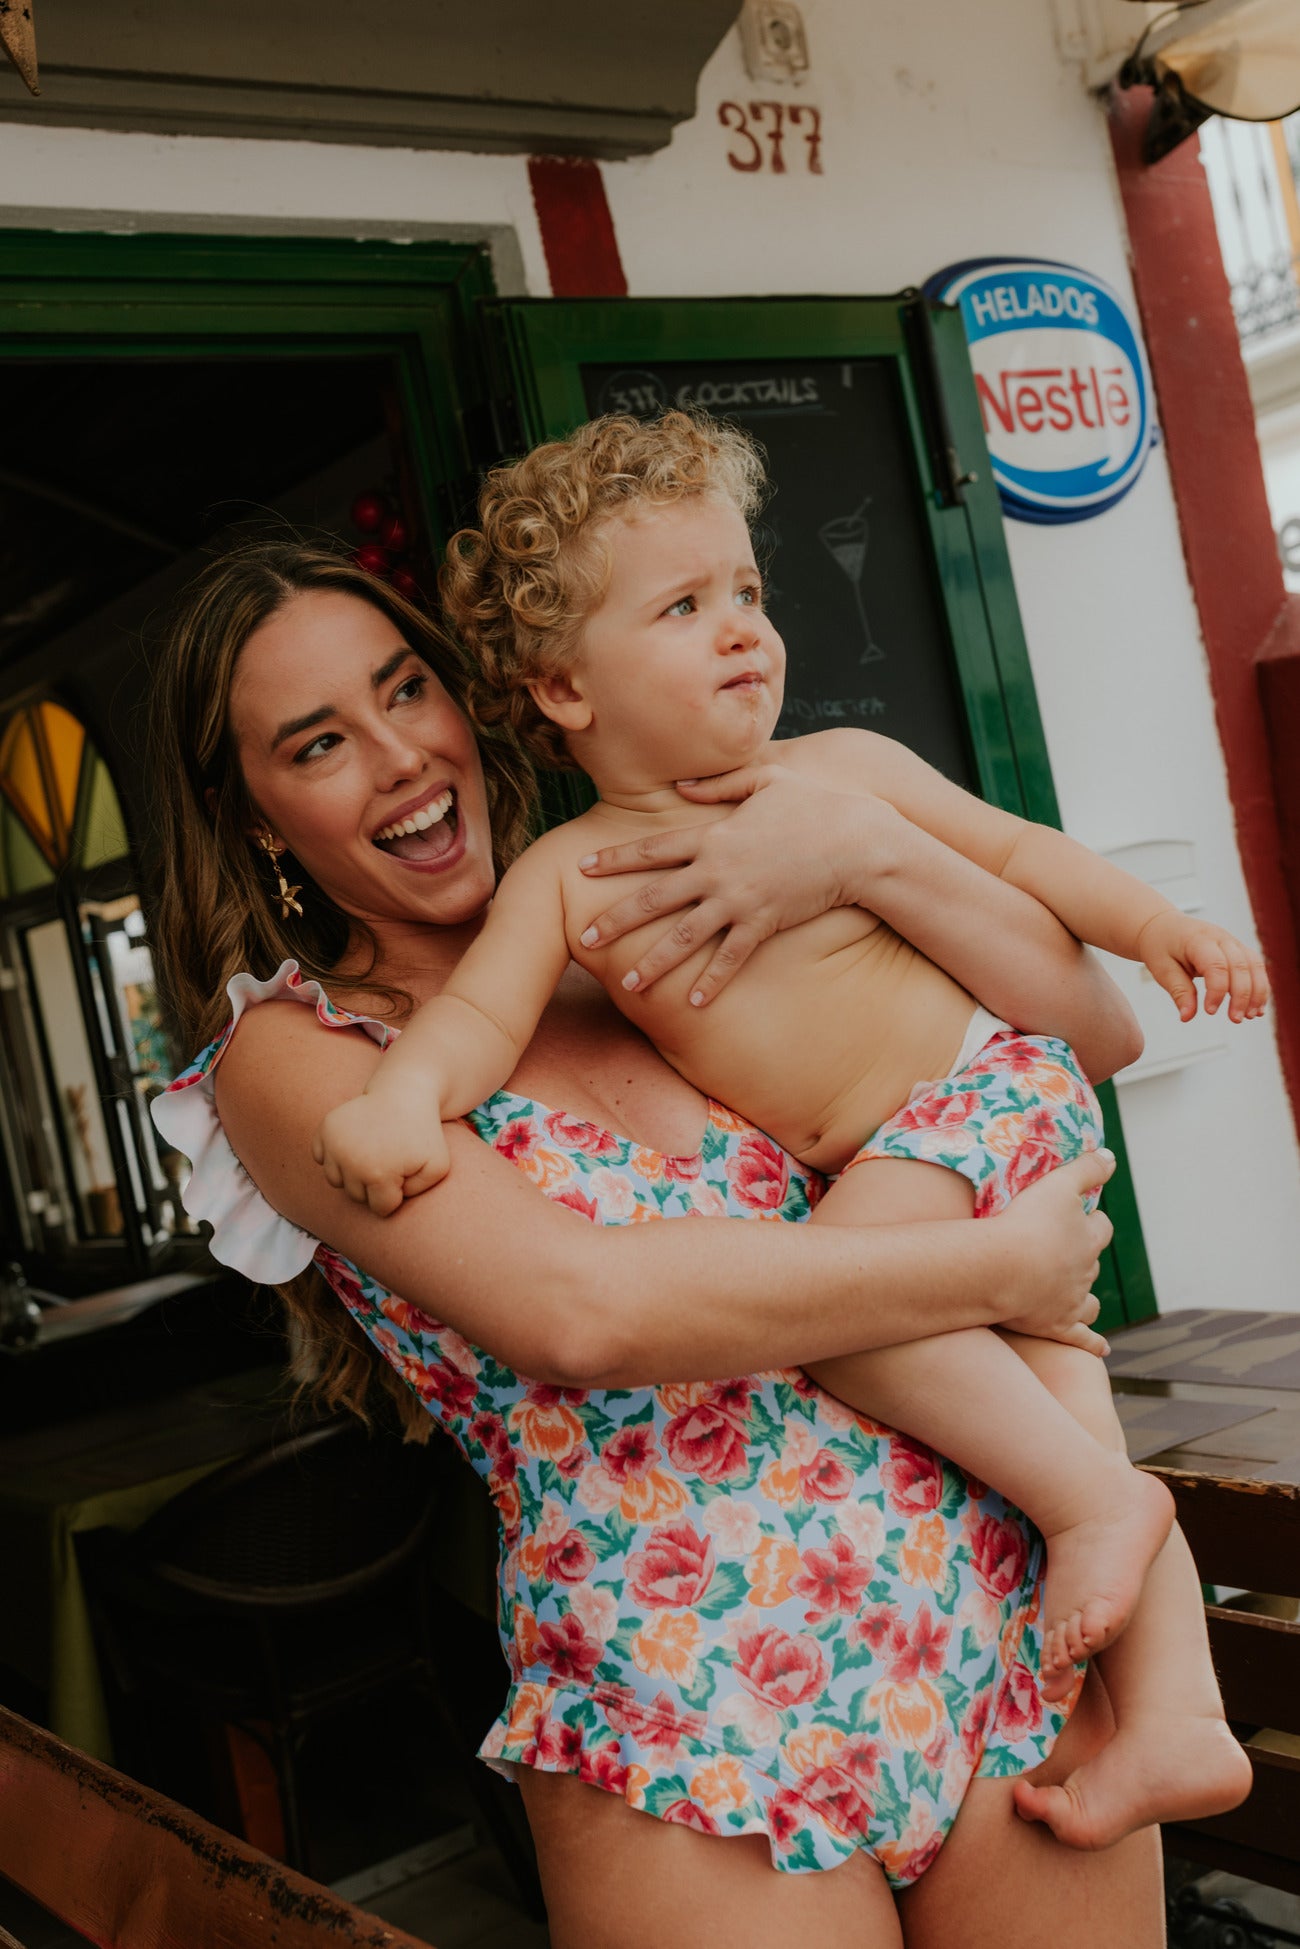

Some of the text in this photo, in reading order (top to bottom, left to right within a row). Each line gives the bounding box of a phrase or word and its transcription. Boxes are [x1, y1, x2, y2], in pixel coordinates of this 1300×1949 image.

[718, 101, 823, 176] 377
[970, 283, 1100, 327] HELADOS
[676, 377, 819, 407] COCKTAILS
